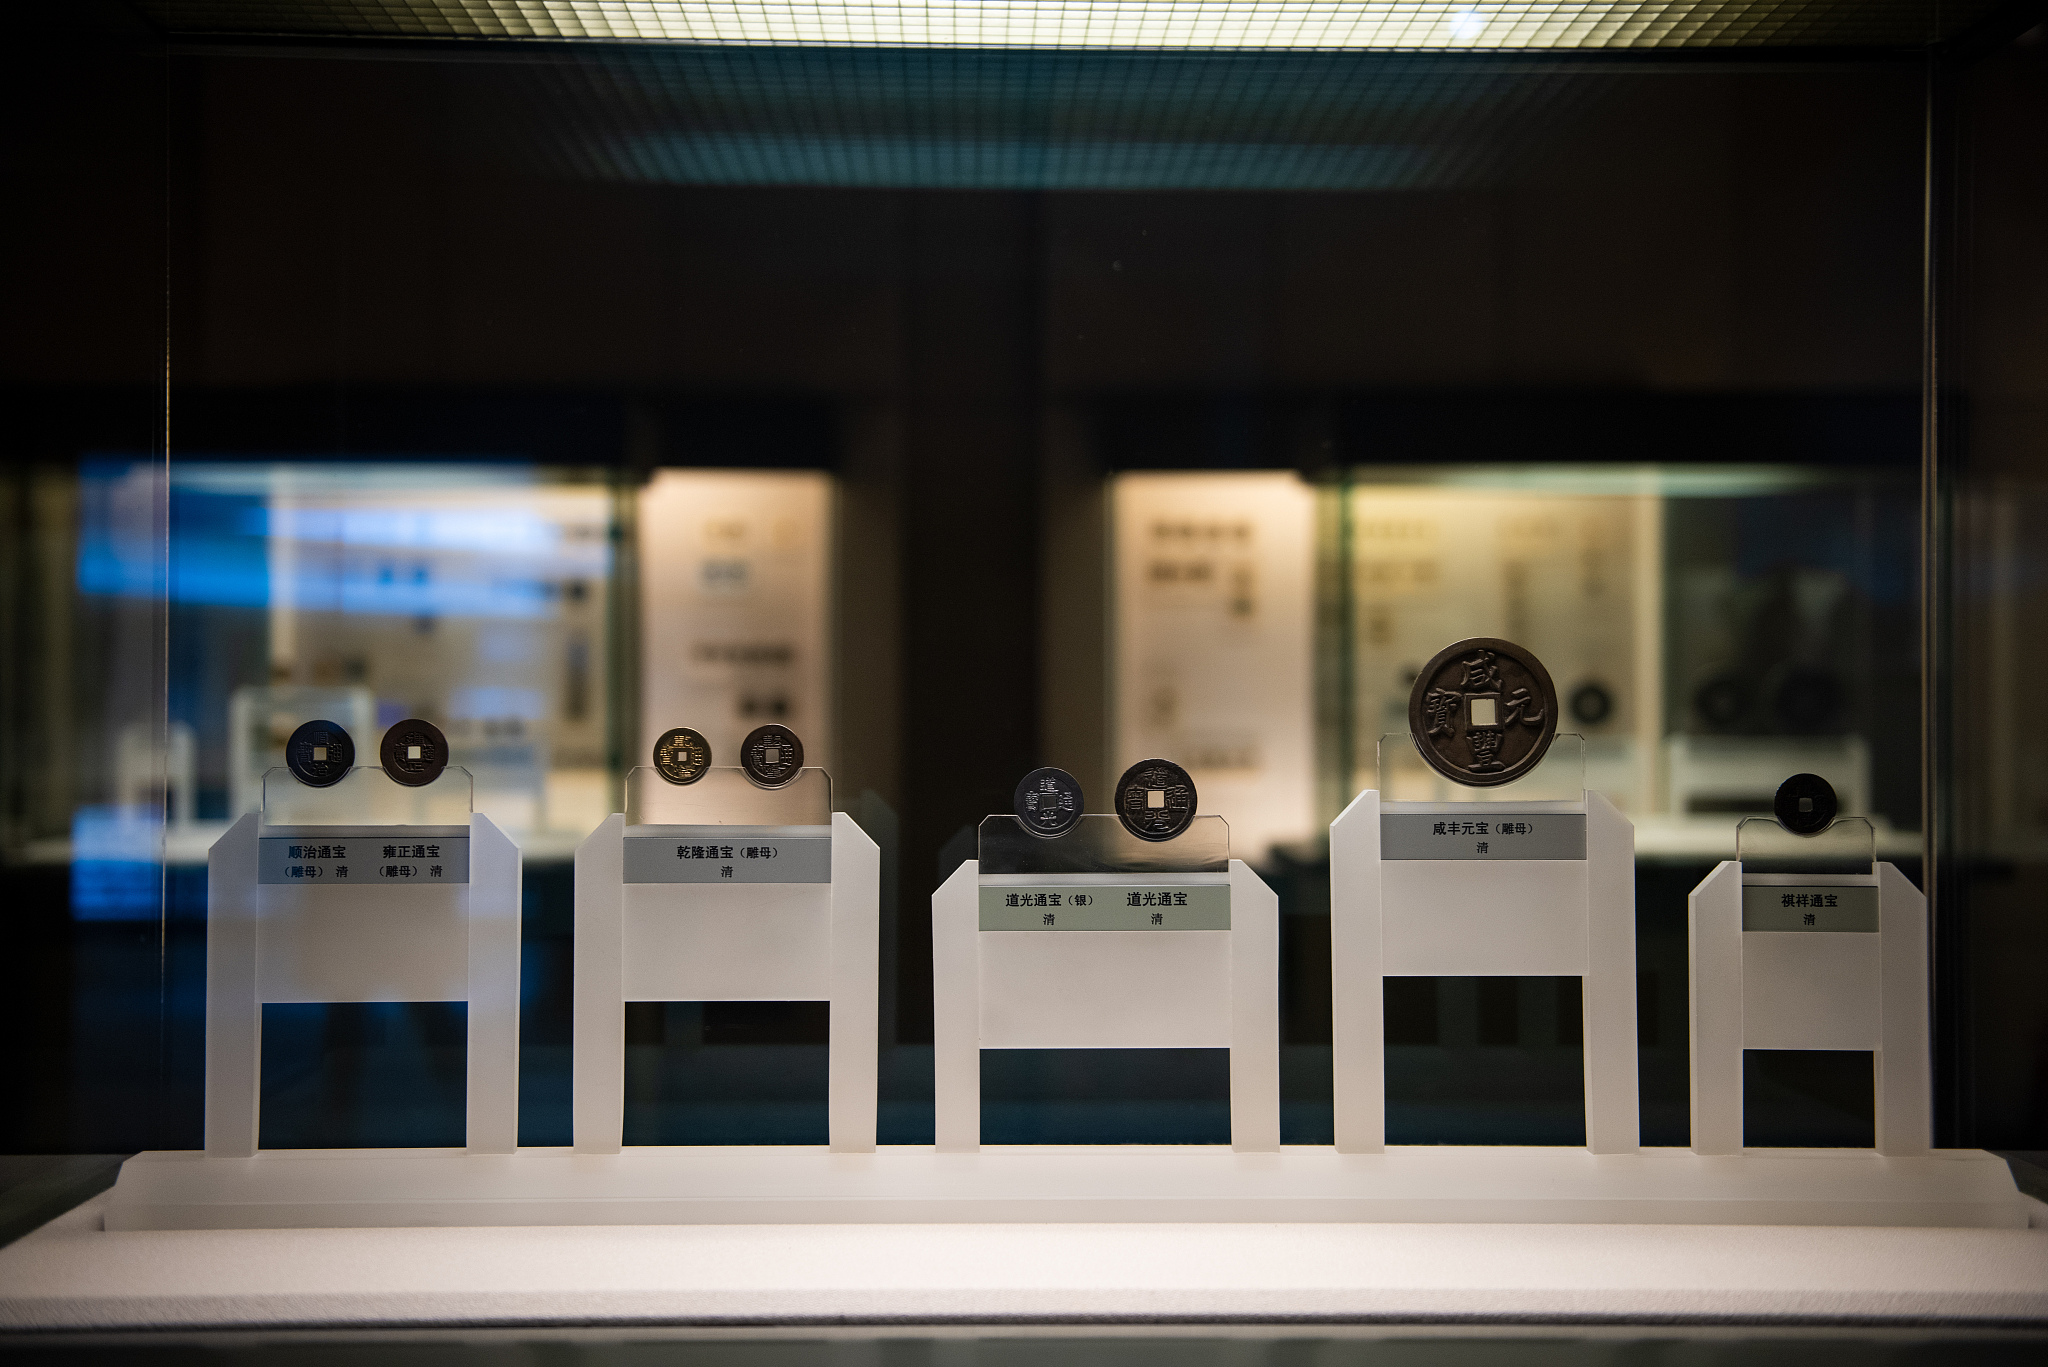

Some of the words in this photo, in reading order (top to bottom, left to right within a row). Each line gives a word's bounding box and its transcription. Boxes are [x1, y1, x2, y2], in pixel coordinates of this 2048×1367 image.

[1461, 649, 1502, 689] 咸
[1504, 687, 1544, 725] 元
[288, 845, 346, 859] 顺治通宝
[382, 845, 440, 858] 雍正通宝
[1476, 842, 1489, 854] 清
[336, 866, 348, 878] 清
[430, 865, 443, 878] 清
[721, 866, 734, 878] 清
[1126, 892, 1188, 906] 道光通宝
[1781, 893, 1838, 908] 祺祥通宝
[1043, 913, 1055, 925] 清
[1151, 913, 1163, 925] 清
[1803, 913, 1816, 926] 清
